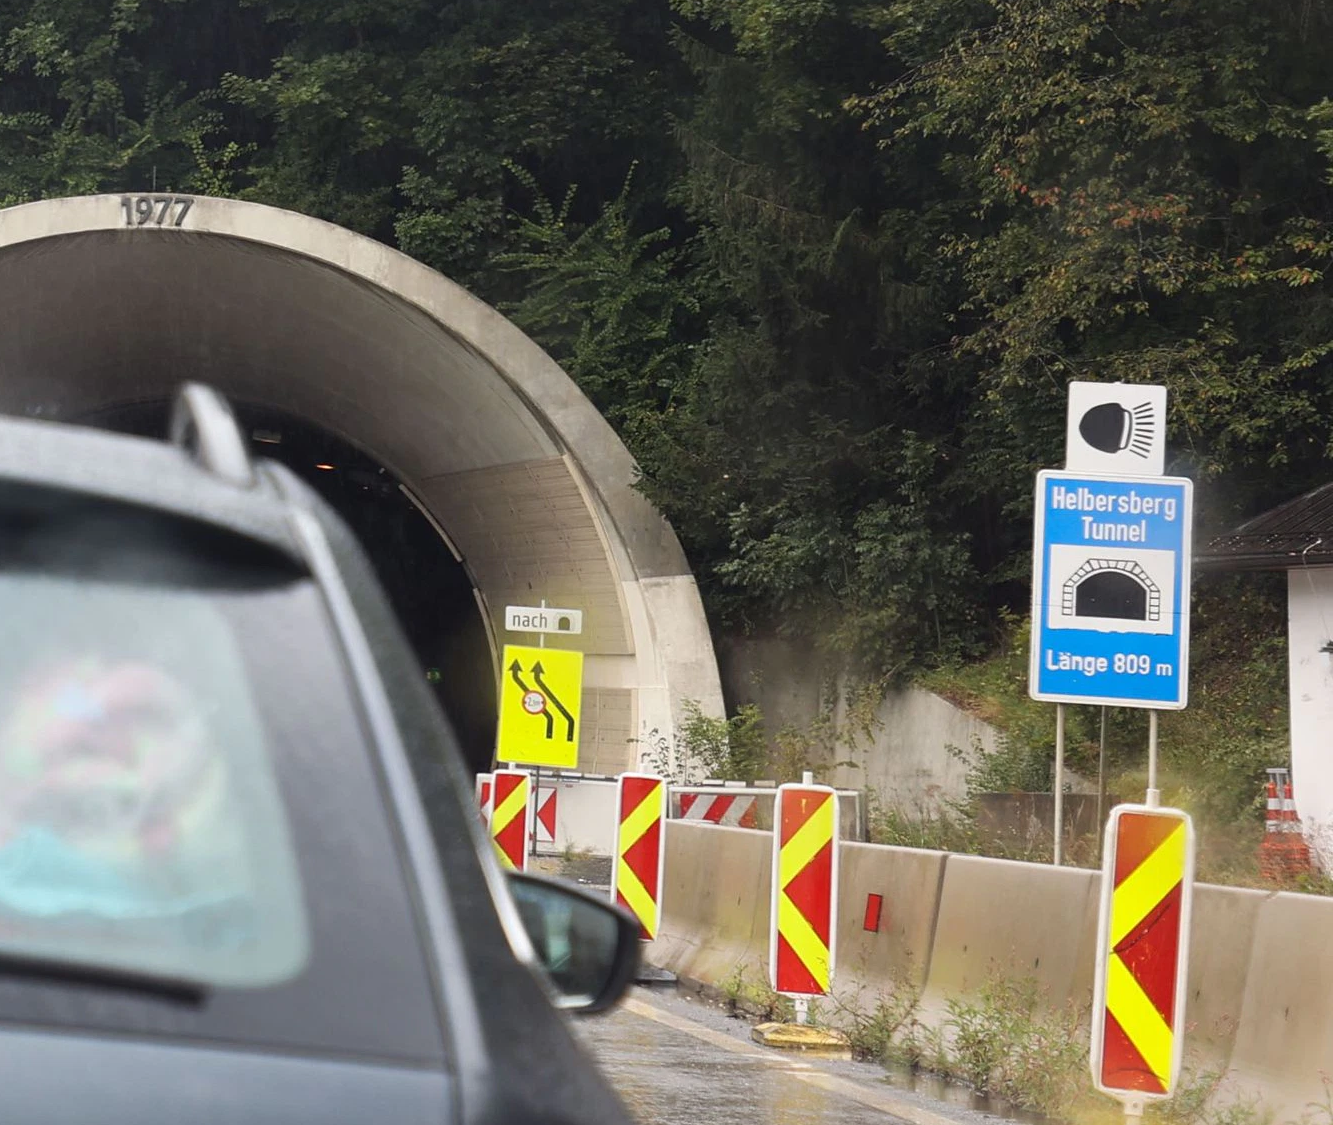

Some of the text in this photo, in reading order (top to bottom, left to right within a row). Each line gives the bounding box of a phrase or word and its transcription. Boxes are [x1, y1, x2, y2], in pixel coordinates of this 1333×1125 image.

[121, 195, 195, 226] 1977
[1052, 486, 1177, 522] Helbersberg
[1081, 516, 1146, 543] Tunnel
[512, 612, 548, 629] nach
[1046, 649, 1173, 676] Länge 809 m
